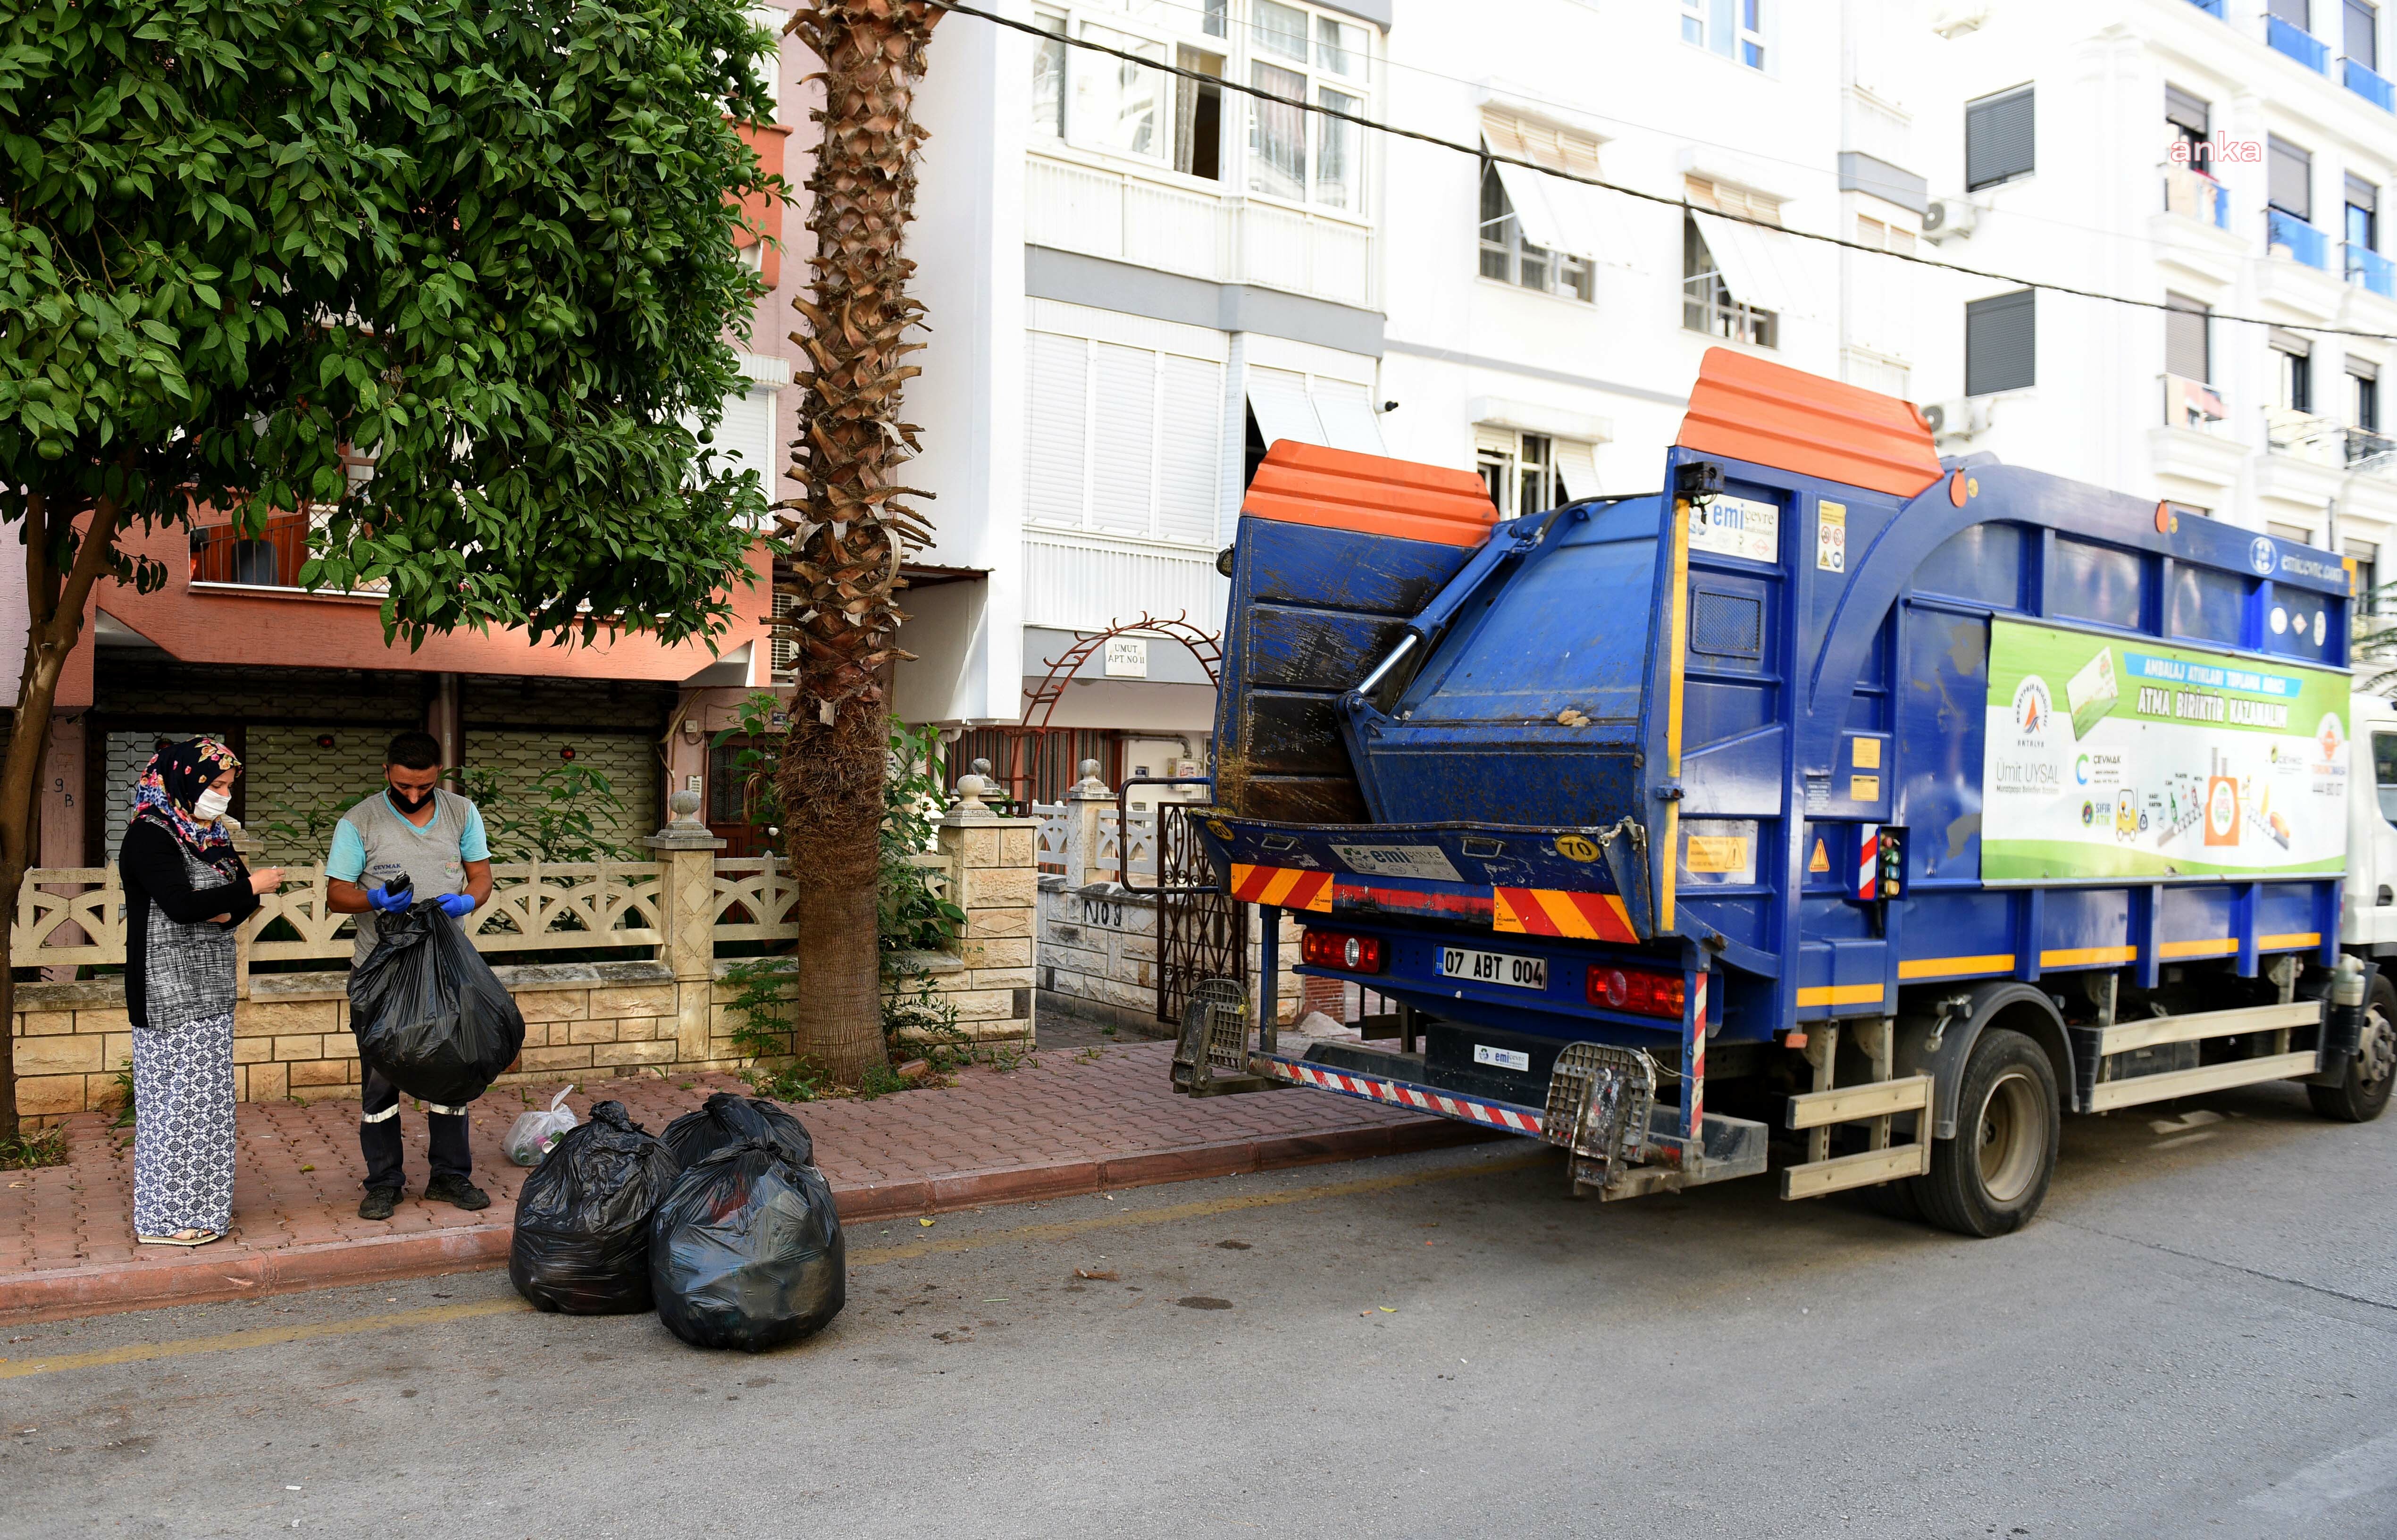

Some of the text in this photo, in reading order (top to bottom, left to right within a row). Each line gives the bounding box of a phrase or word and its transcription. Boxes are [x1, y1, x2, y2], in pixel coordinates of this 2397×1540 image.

[1115, 644, 1138, 653] UMUT
[1108, 654, 1124, 663] APT
[1127, 655, 1138, 663] NO
[2137, 686, 2170, 718] ATMA
[2175, 684, 2224, 724] BİRİKTİR
[2093, 755, 2121, 765] ÇEVMAK
[1996, 757, 2060, 784] Ümit UYSAL
[54, 778, 63, 792] 9
[65, 794, 74, 808] B
[2096, 803, 2111, 813] SIFIR
[2096, 815, 2111, 826] ATIK
[1561, 842, 1592, 856] 70
[1445, 951, 1543, 986] 07 ABT 004
